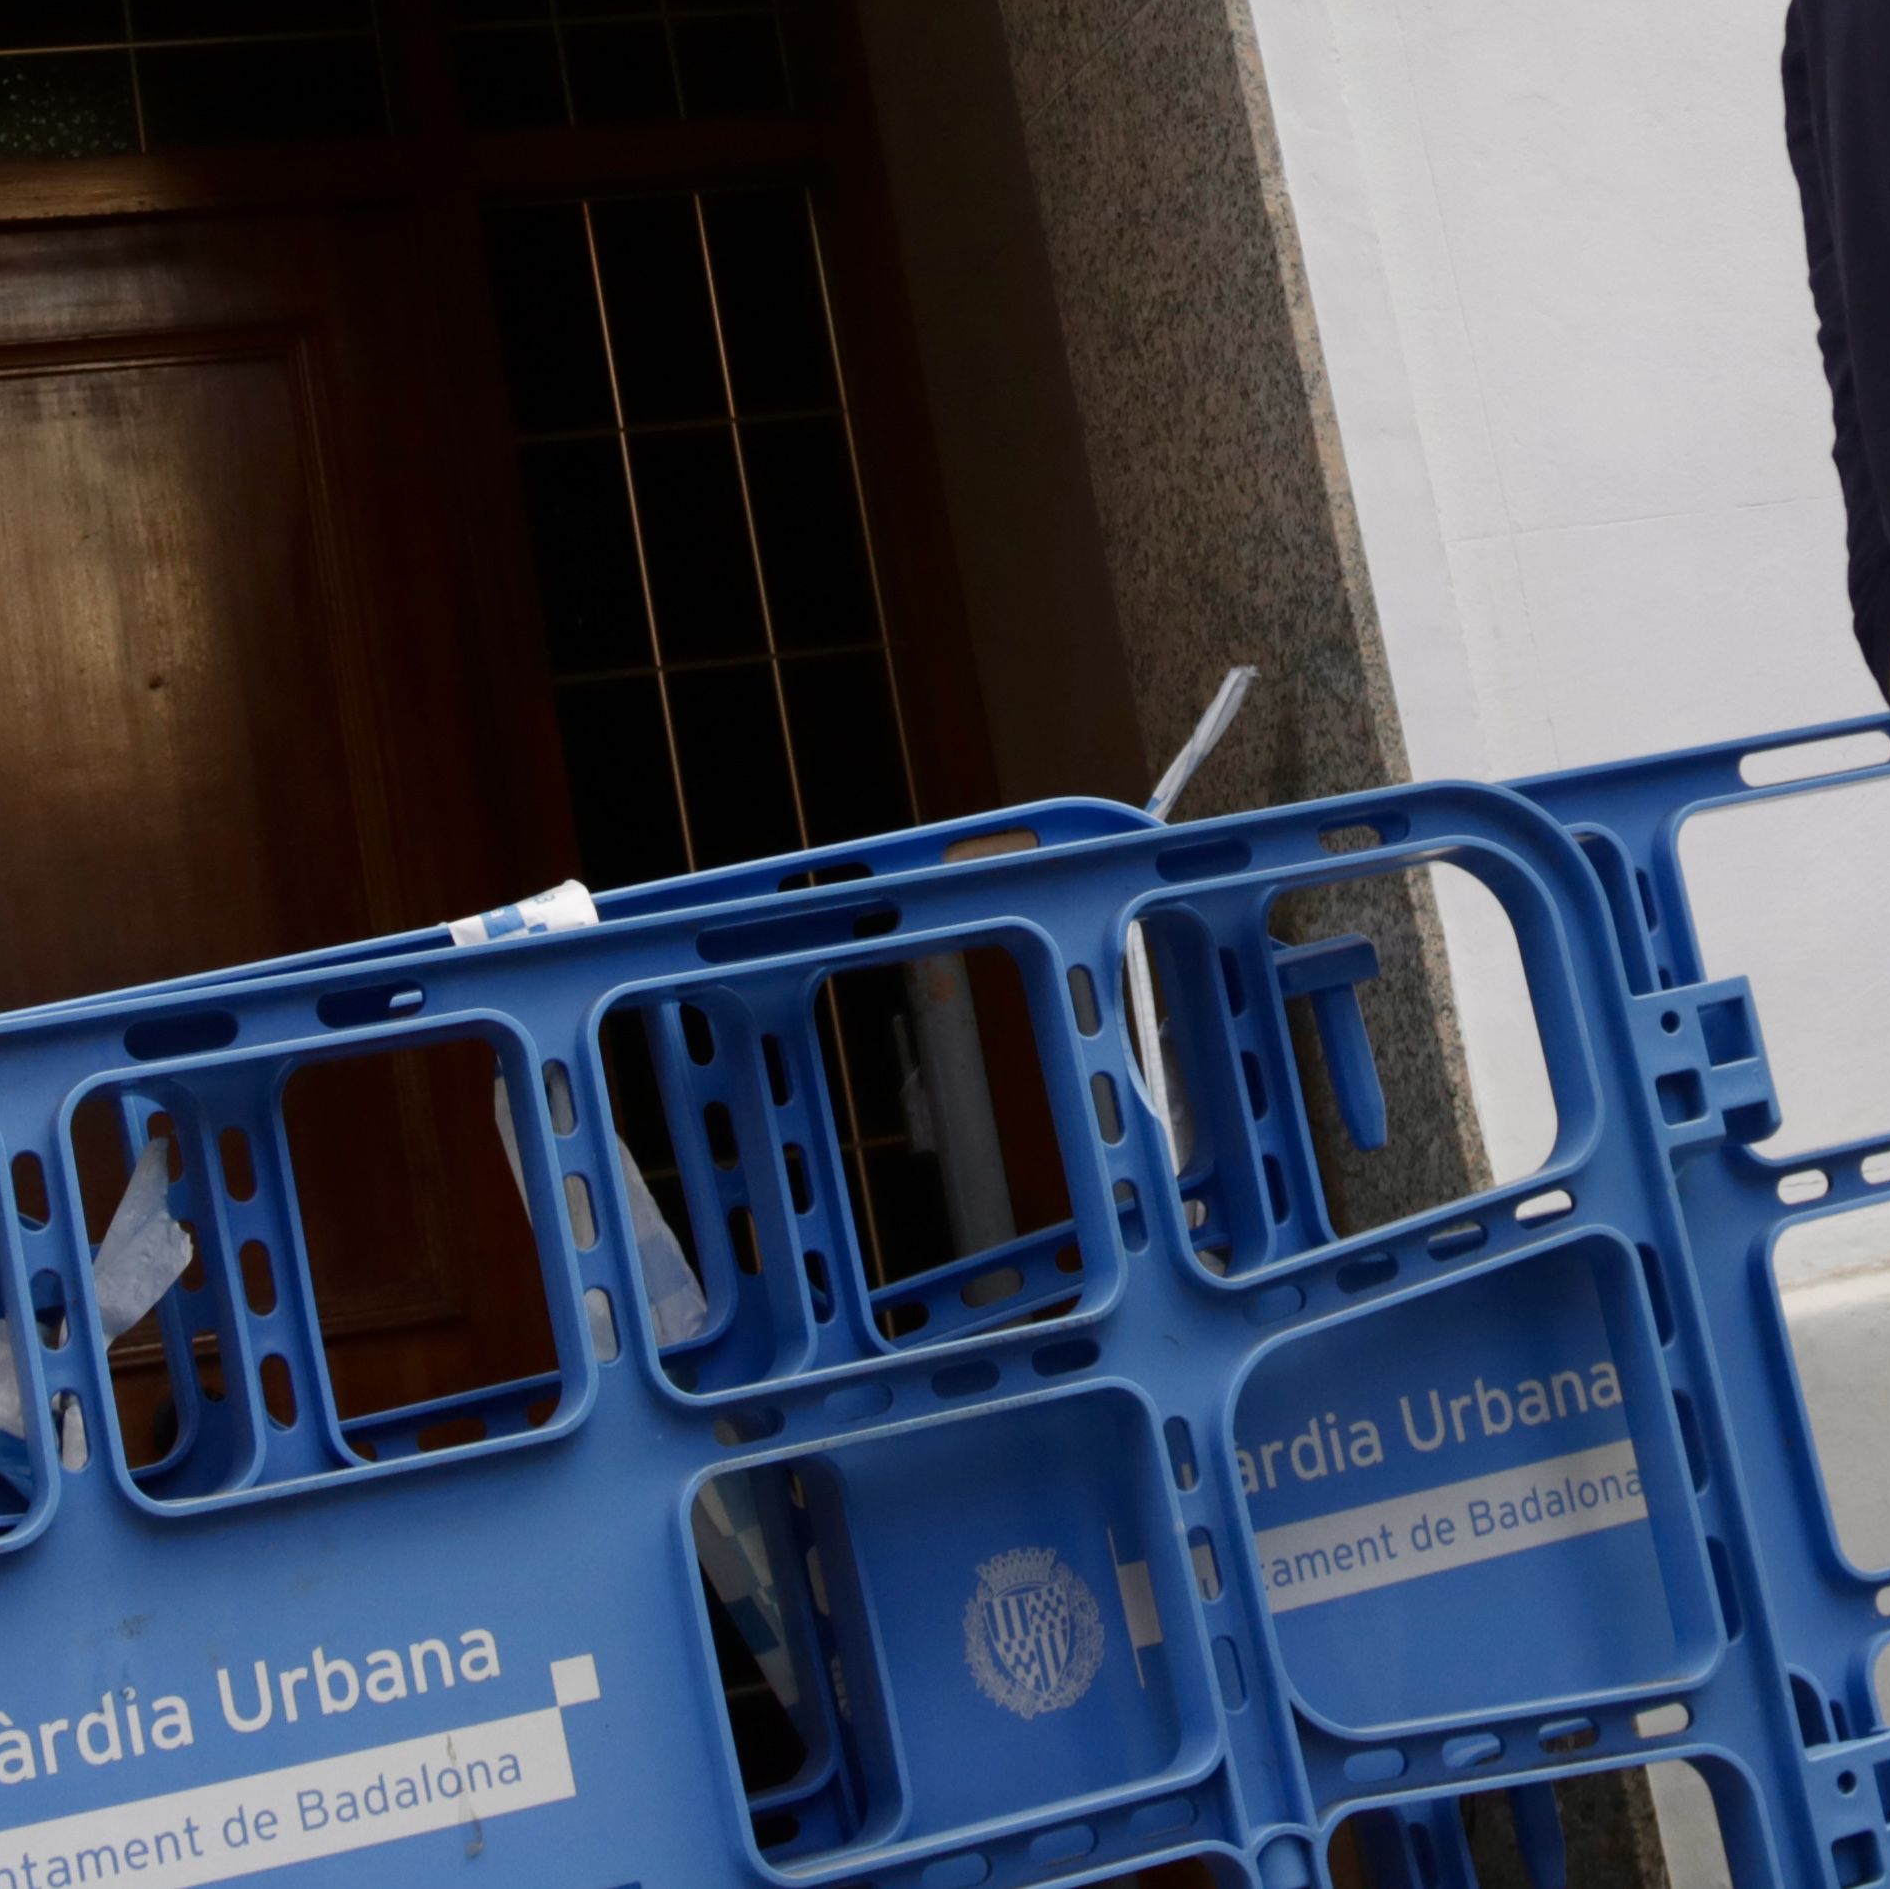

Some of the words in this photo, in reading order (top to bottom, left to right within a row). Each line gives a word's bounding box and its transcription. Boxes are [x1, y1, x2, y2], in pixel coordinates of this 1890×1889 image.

[1398, 1360, 1624, 1452] Urbana
[1410, 1513, 1457, 1553] de
[1467, 1468, 1643, 1538] Badalona
[216, 1628, 502, 1734] Urbana
[221, 1804, 279, 1850] de
[295, 1751, 523, 1832] Badalona
